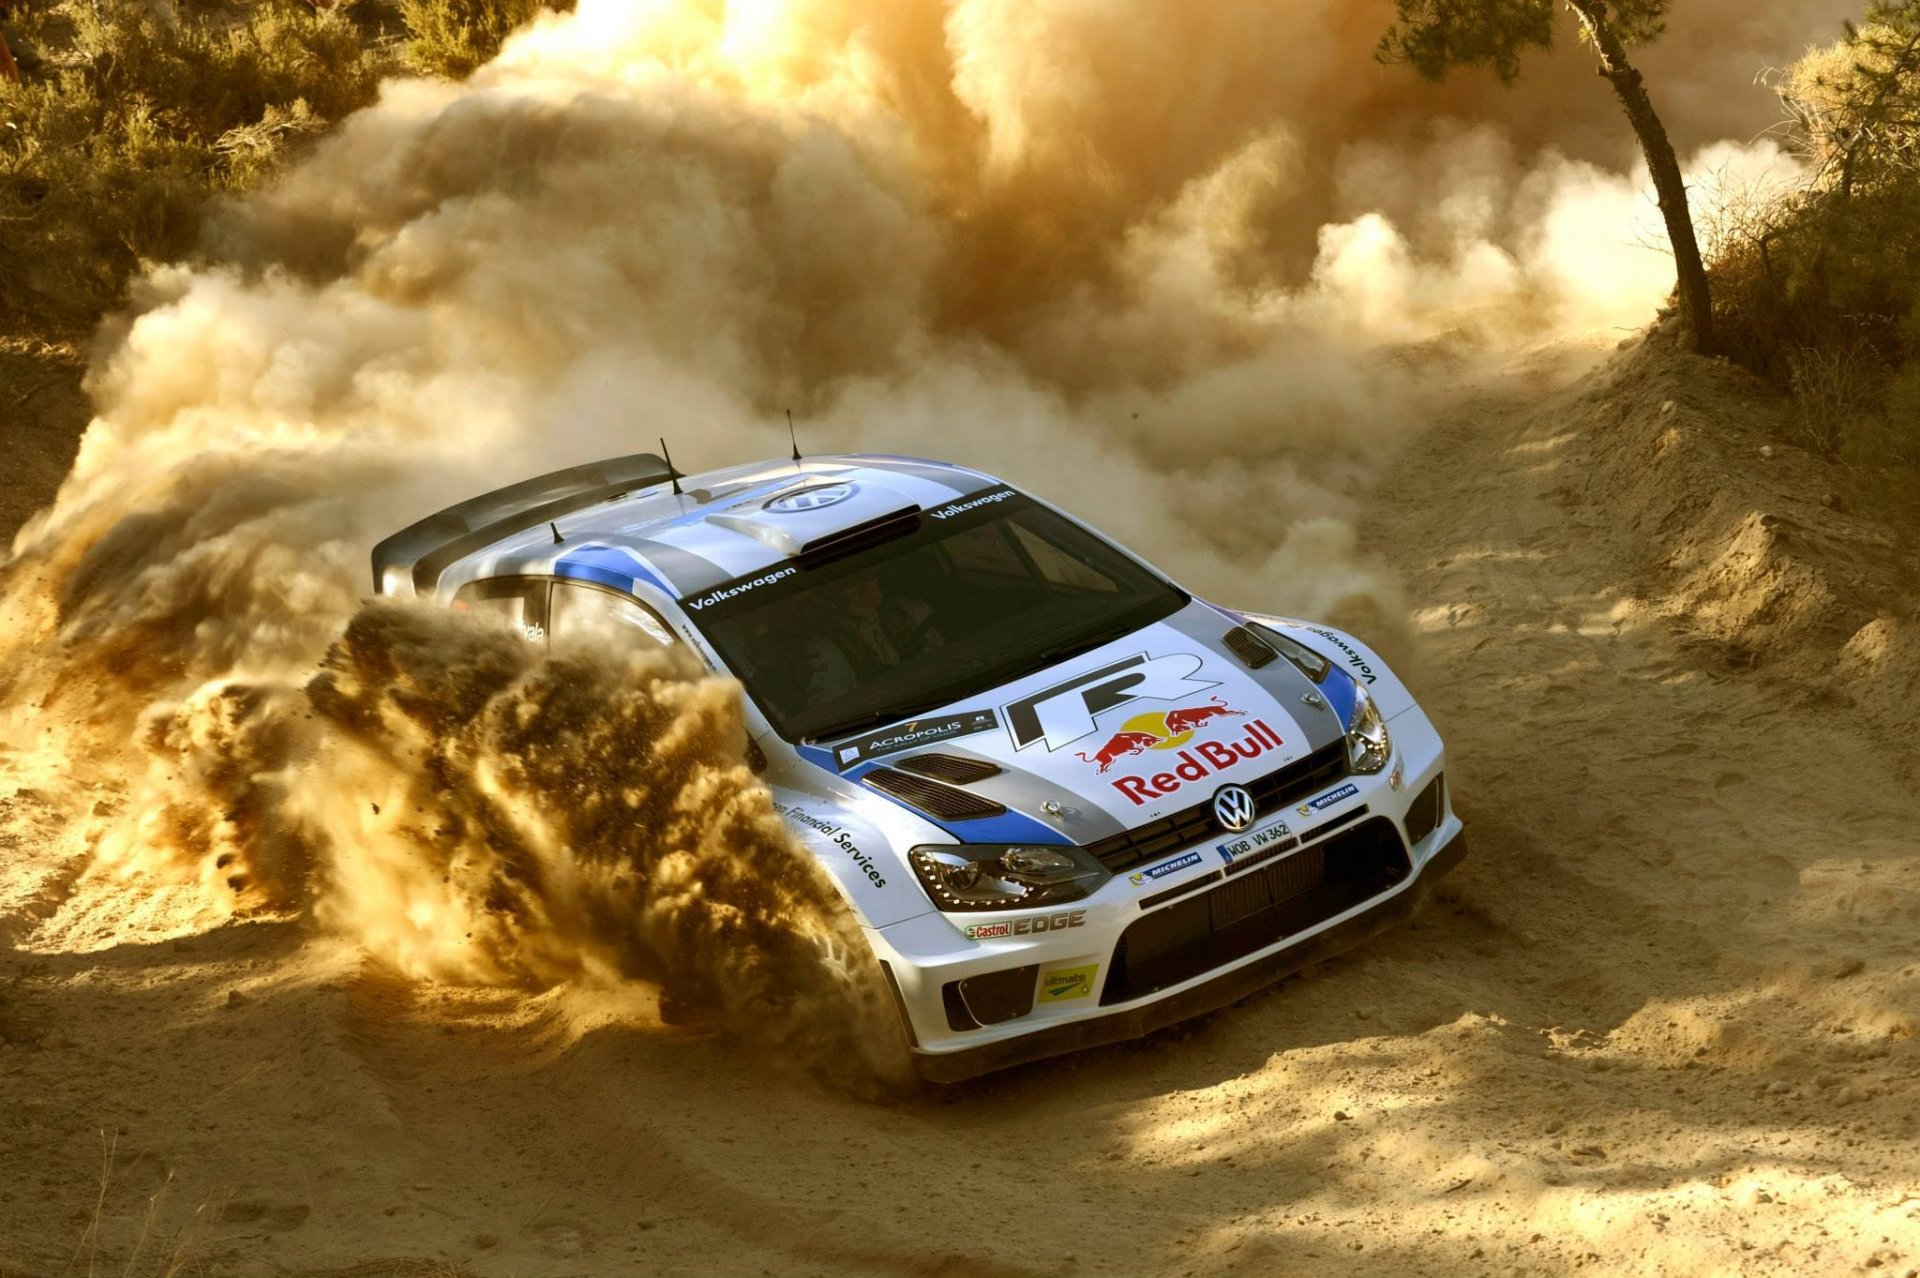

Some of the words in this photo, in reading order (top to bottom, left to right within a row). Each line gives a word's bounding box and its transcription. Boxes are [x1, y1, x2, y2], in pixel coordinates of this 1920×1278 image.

[930, 488, 1016, 522] Volkswagen
[688, 565, 797, 611] Volkswagen
[1305, 626, 1377, 685] Volkswagen
[869, 721, 961, 750] ACROPOLIS
[1111, 750, 1209, 806] Red
[1195, 719, 1285, 771] Bull
[1315, 785, 1355, 807] MICHELIN
[787, 806, 840, 836] Financial
[833, 832, 887, 889] Services
[1227, 840, 1251, 857] WOB
[1252, 833, 1269, 846] VW
[1267, 824, 1289, 840] 362
[1151, 854, 1198, 876] MICHELIN
[976, 926, 1009, 938] Castrol
[1014, 910, 1087, 936] EDGE
[1044, 972, 1086, 986] ultimate
